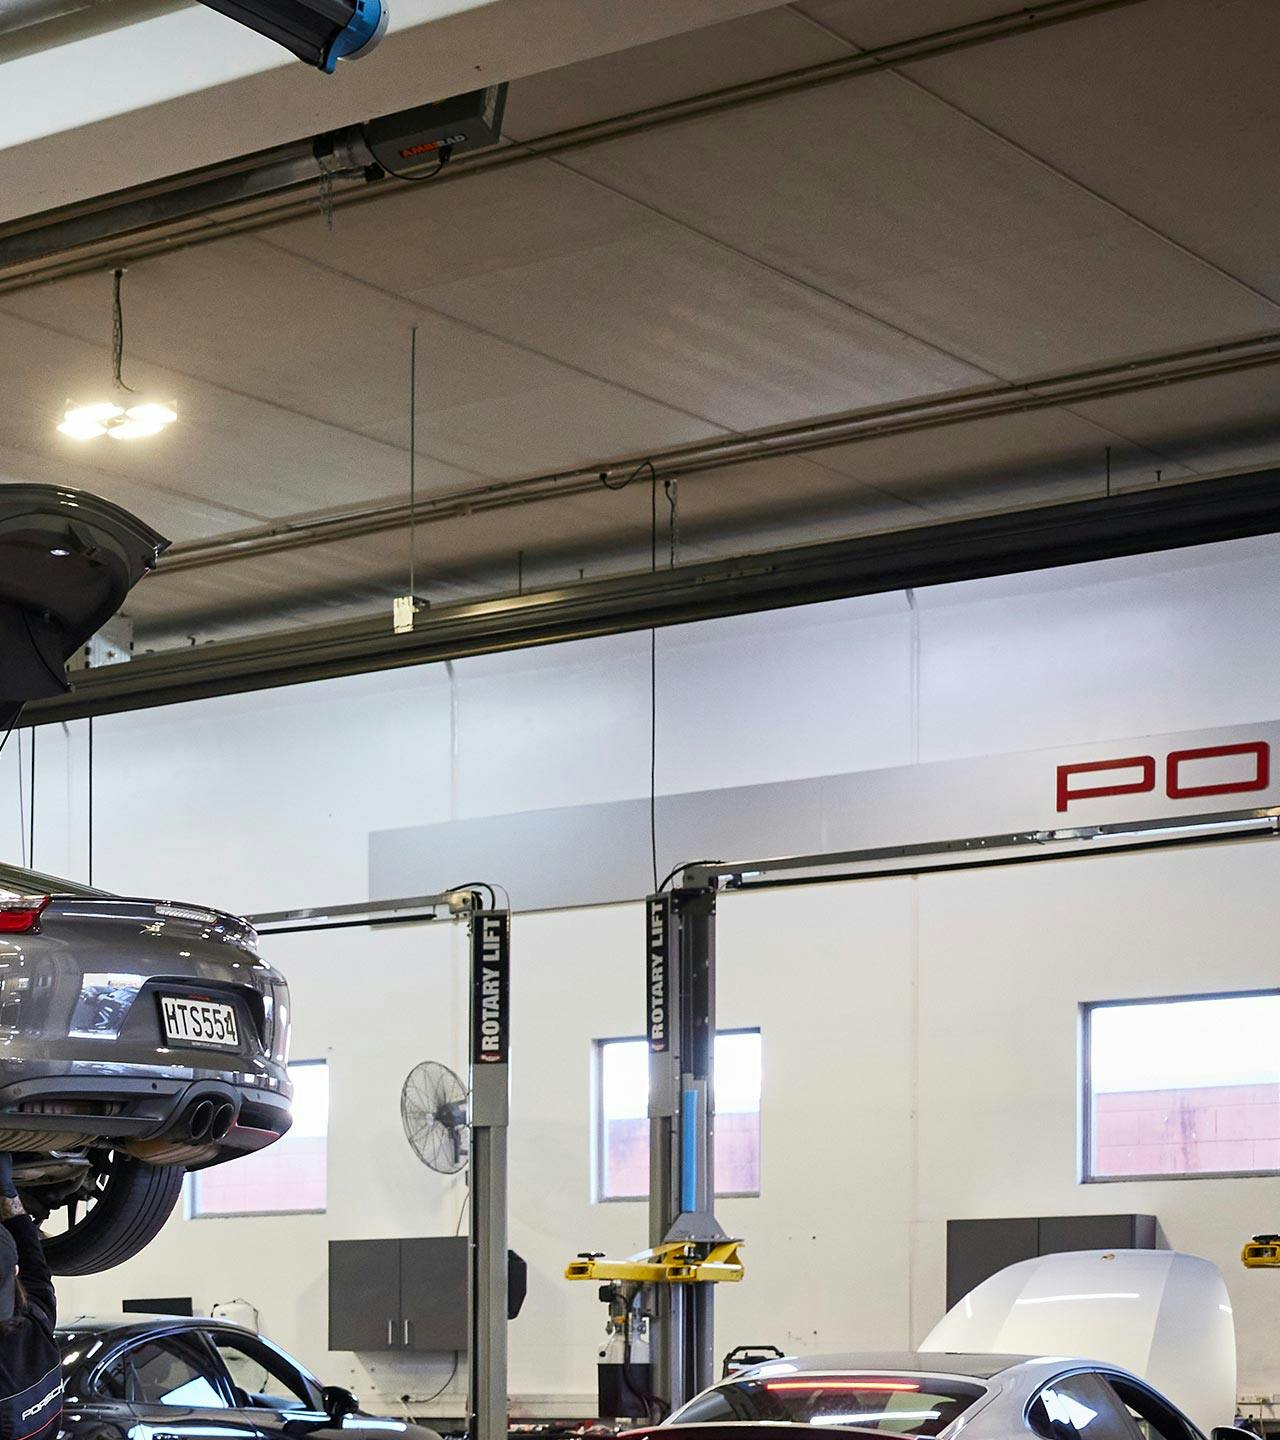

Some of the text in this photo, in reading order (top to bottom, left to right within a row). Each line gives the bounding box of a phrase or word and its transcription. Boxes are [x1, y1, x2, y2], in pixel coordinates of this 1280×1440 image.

[482, 917, 500, 961] LIFT
[651, 902, 664, 947] LIFT
[481, 967, 500, 1051] ROTARY
[651, 954, 664, 1039] ROTARY
[164, 1002, 236, 1042] HTS554
